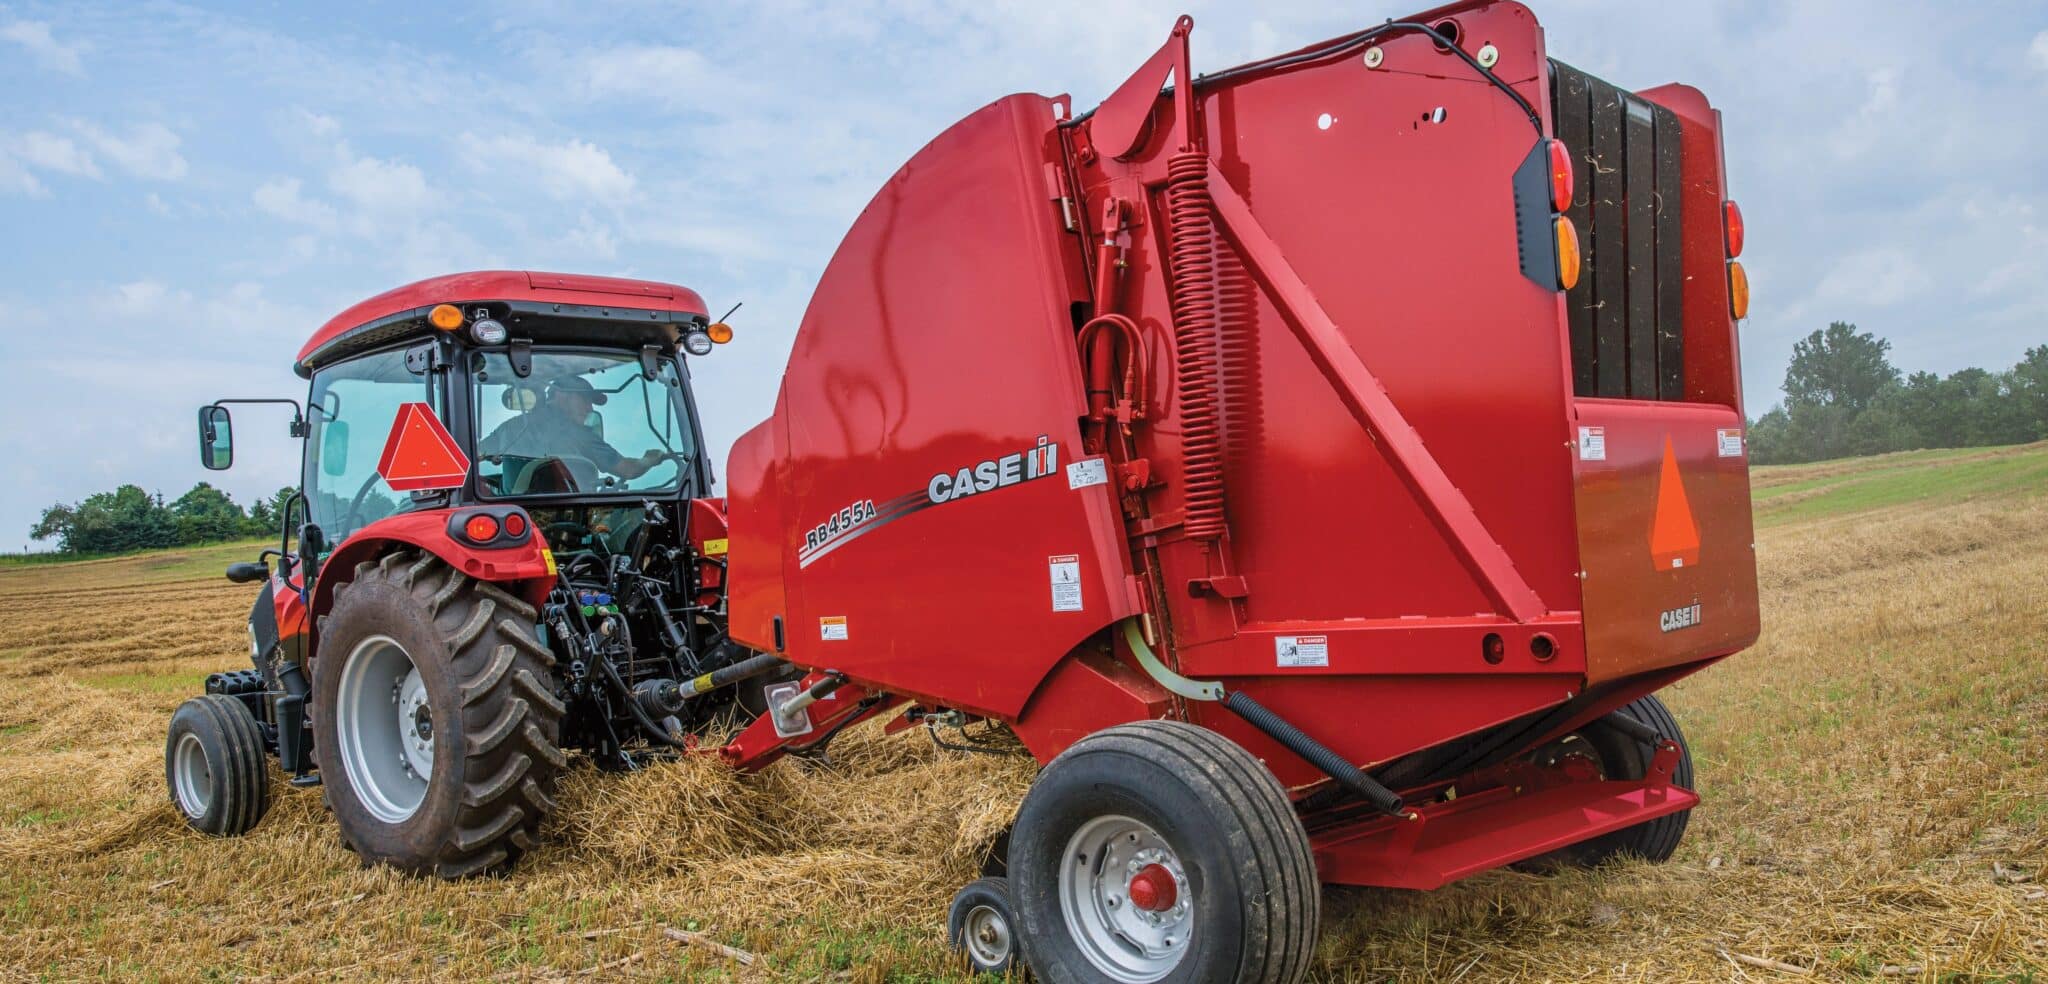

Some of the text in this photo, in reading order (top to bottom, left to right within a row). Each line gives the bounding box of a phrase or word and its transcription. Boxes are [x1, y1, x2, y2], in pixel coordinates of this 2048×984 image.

[928, 453, 1021, 503] CASE
[806, 500, 876, 551] RB455A
[1660, 606, 1690, 632] CASE
